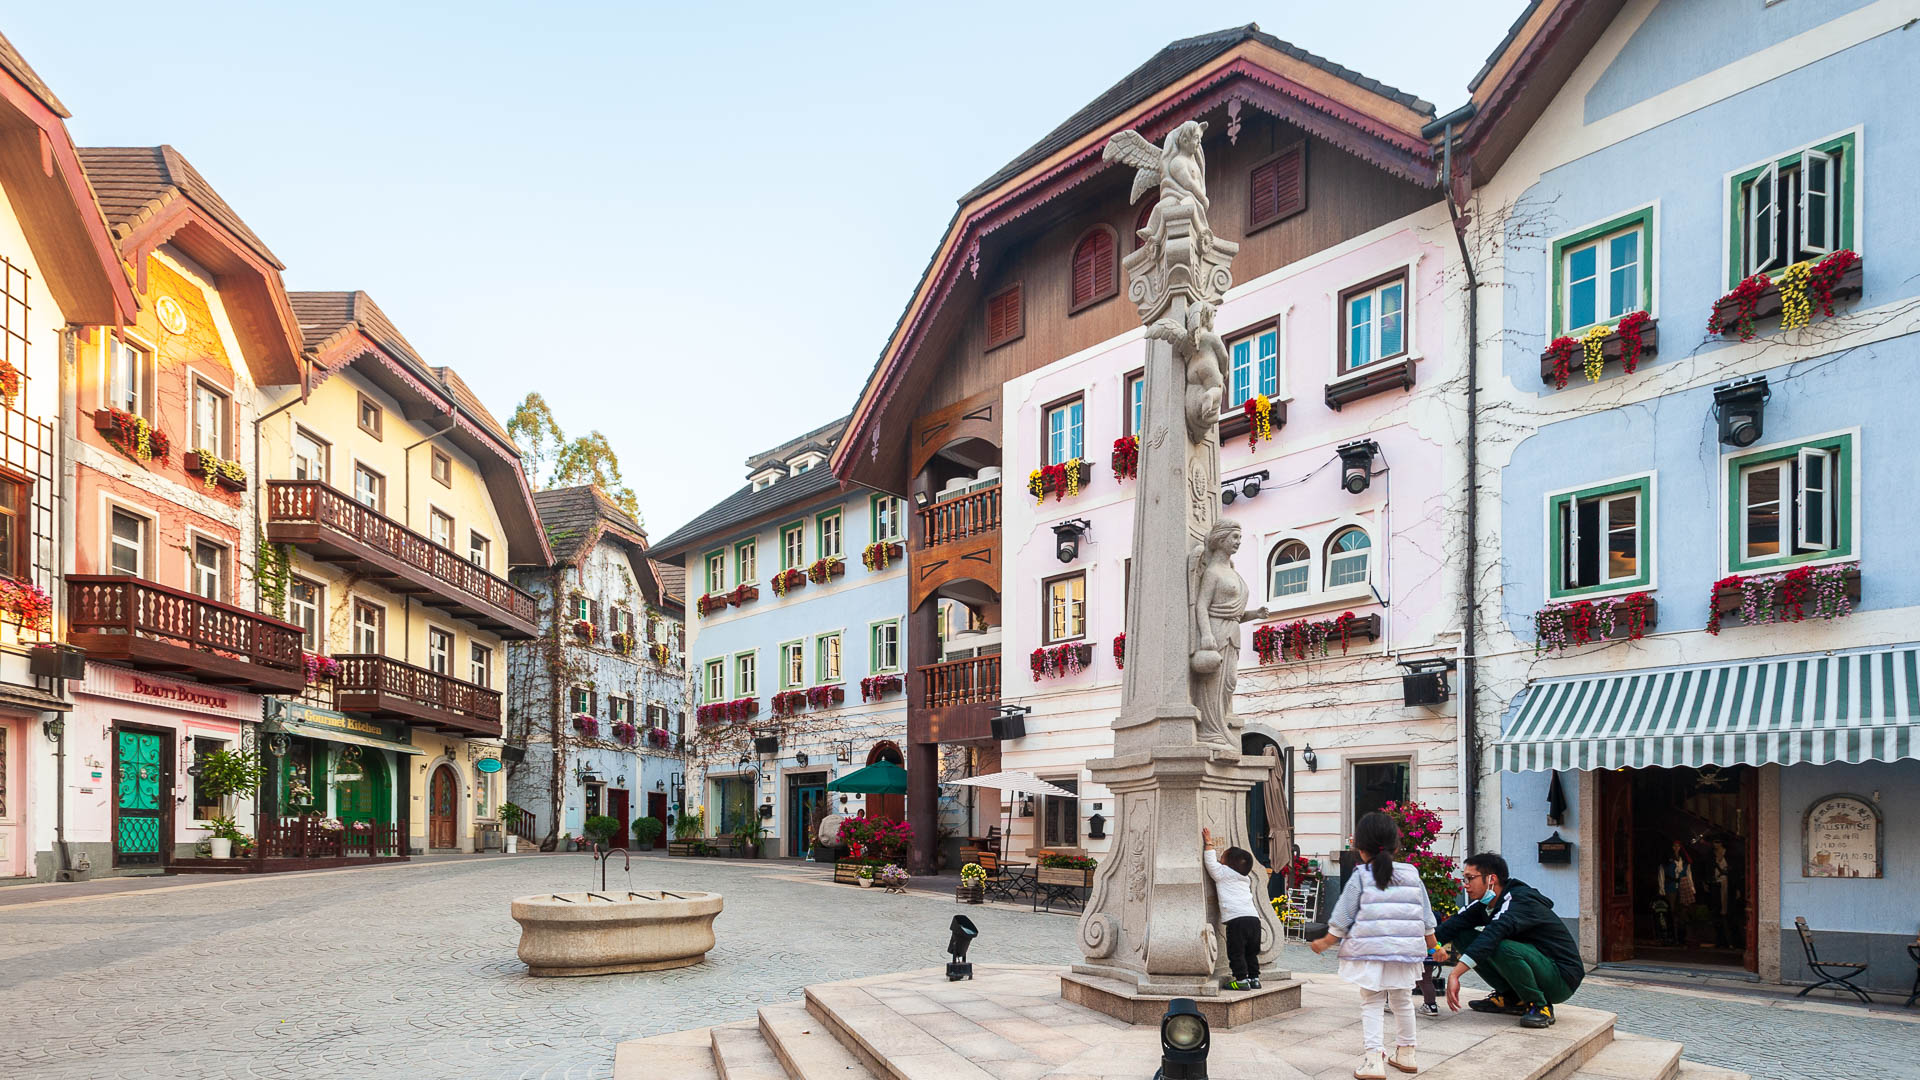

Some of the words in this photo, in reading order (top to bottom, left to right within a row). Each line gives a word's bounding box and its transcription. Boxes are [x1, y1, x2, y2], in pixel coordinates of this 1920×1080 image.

[132, 677, 177, 699] BEAUTY
[176, 685, 227, 708] BOUTIQUE
[304, 710, 346, 728] Gourmet
[347, 718, 382, 735] Kitchen
